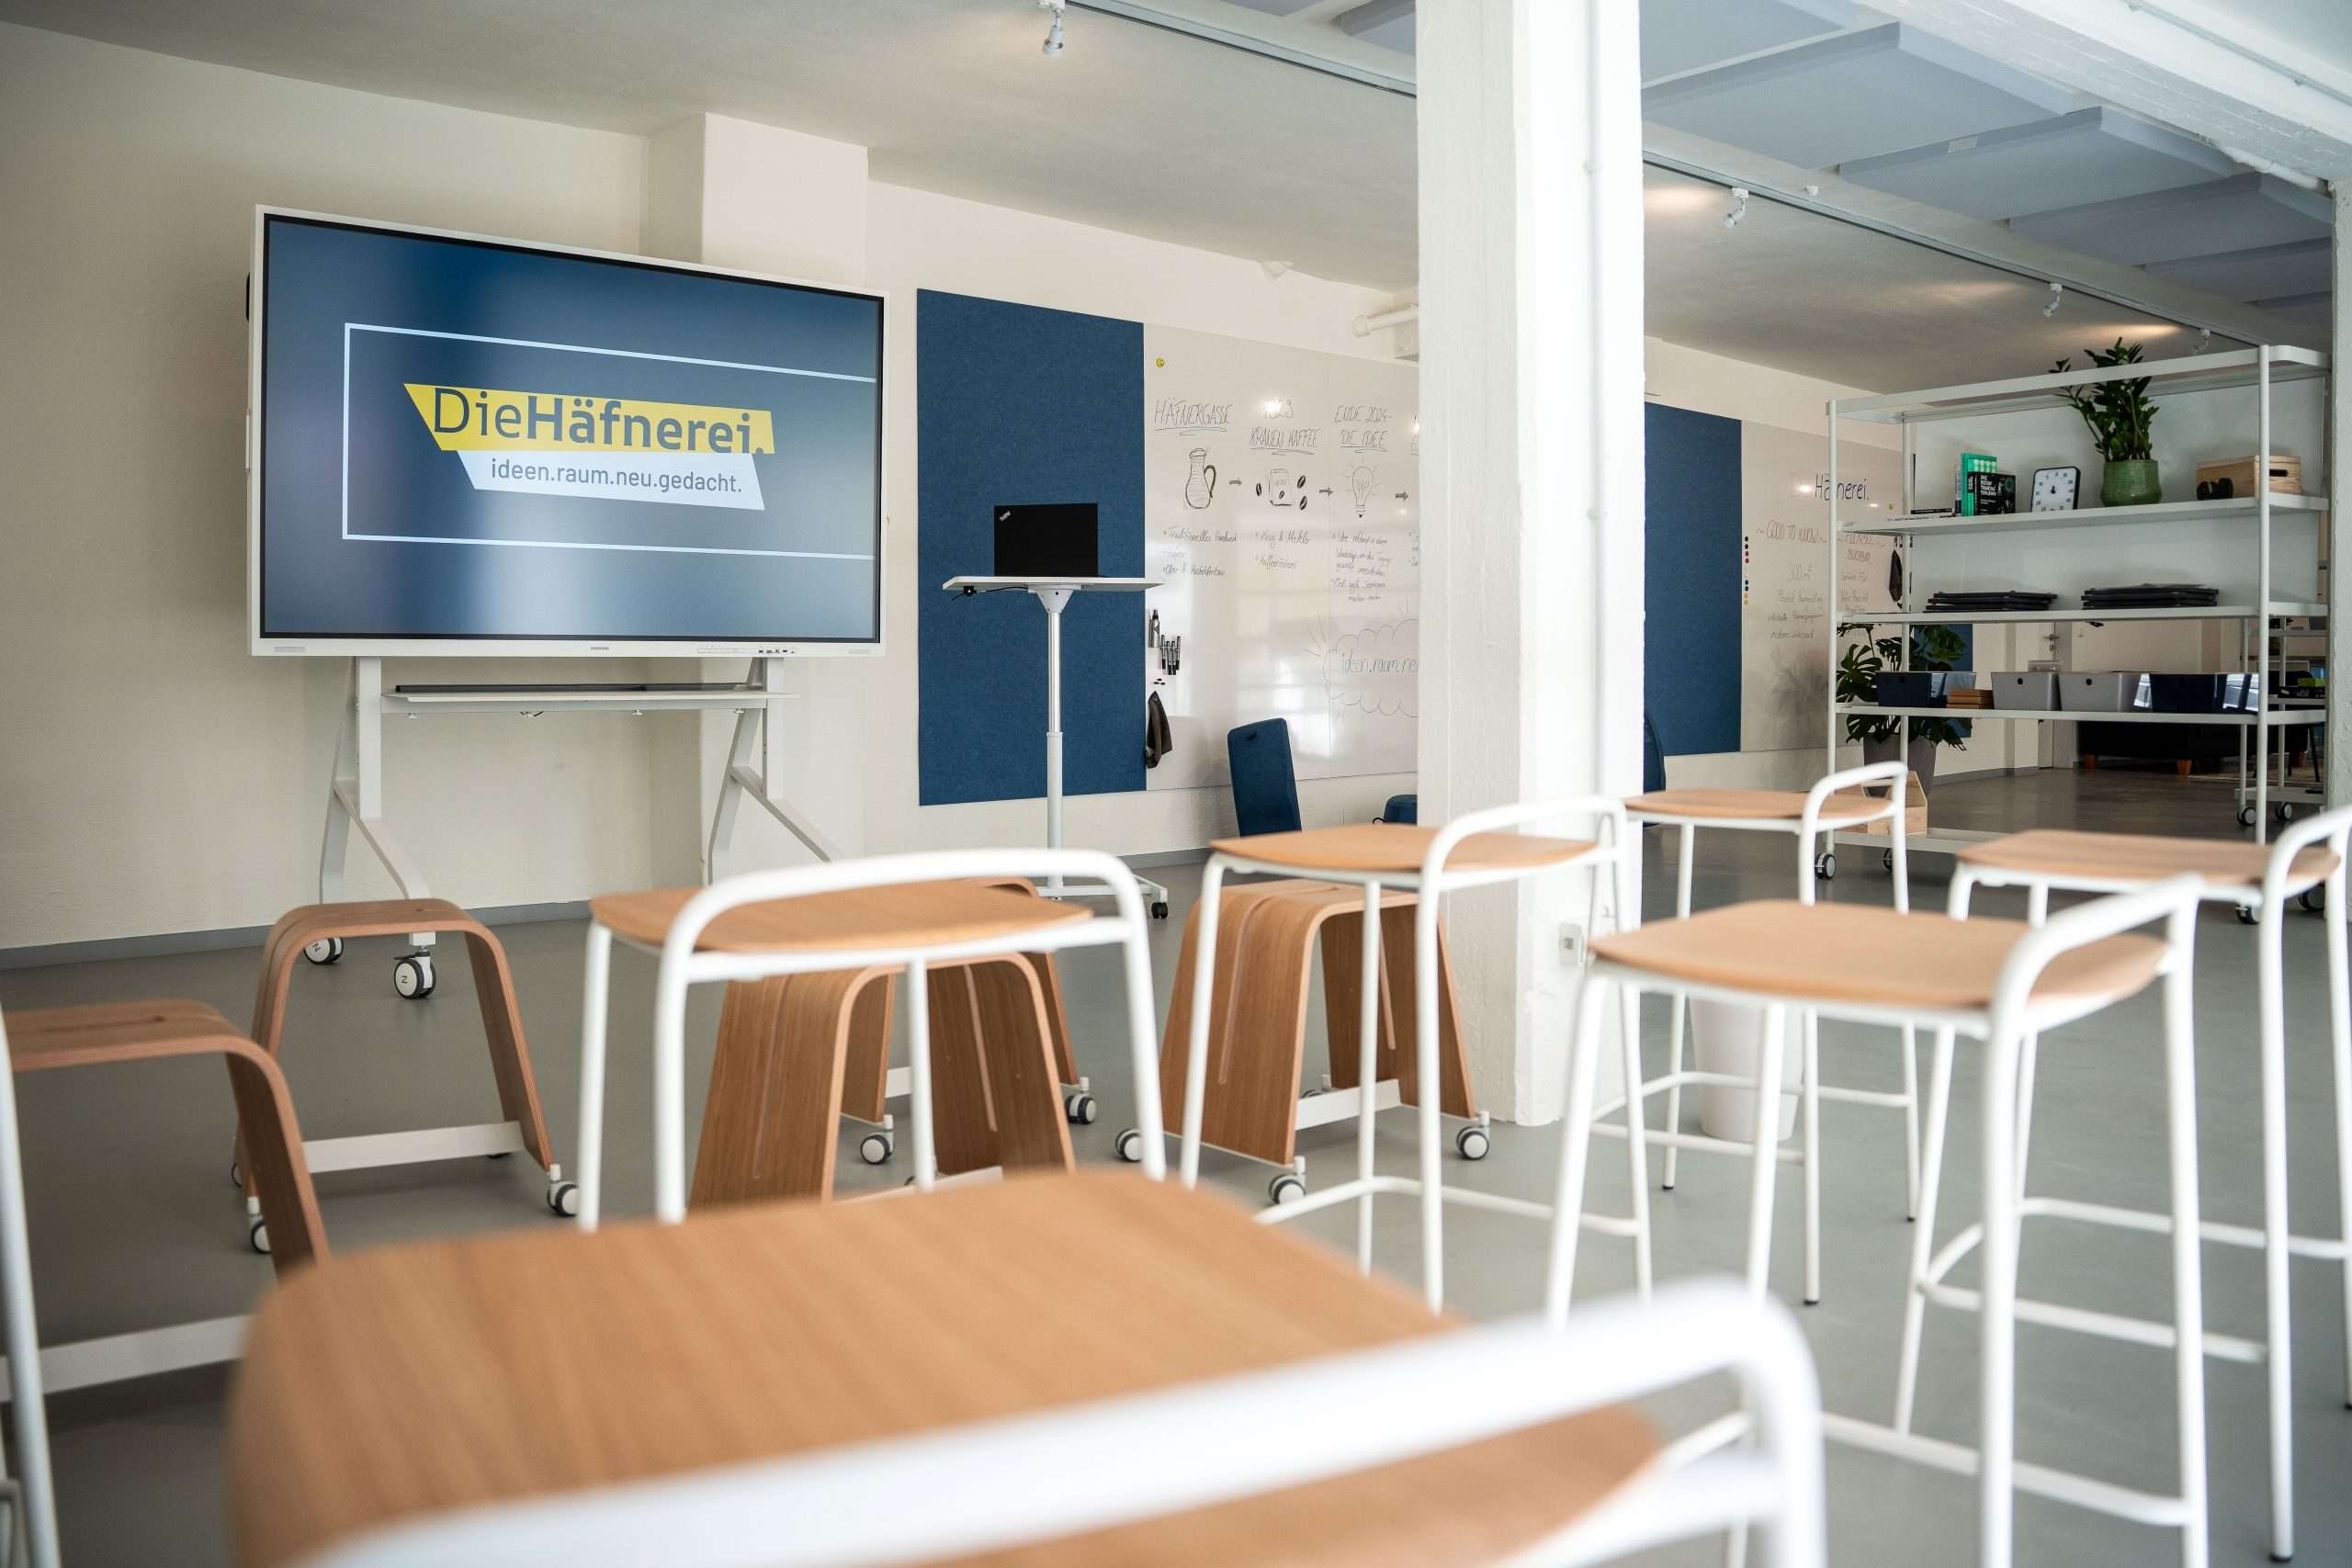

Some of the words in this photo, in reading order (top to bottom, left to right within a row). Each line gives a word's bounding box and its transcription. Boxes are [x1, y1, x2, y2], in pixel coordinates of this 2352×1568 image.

[433, 387, 764, 457] DieHäfnerei.
[1154, 397, 1234, 426] HÄFNERGASSE
[491, 457, 742, 494] ideen.raum.neu.gedacht.
[1815, 472, 1870, 501] Hänerei.
